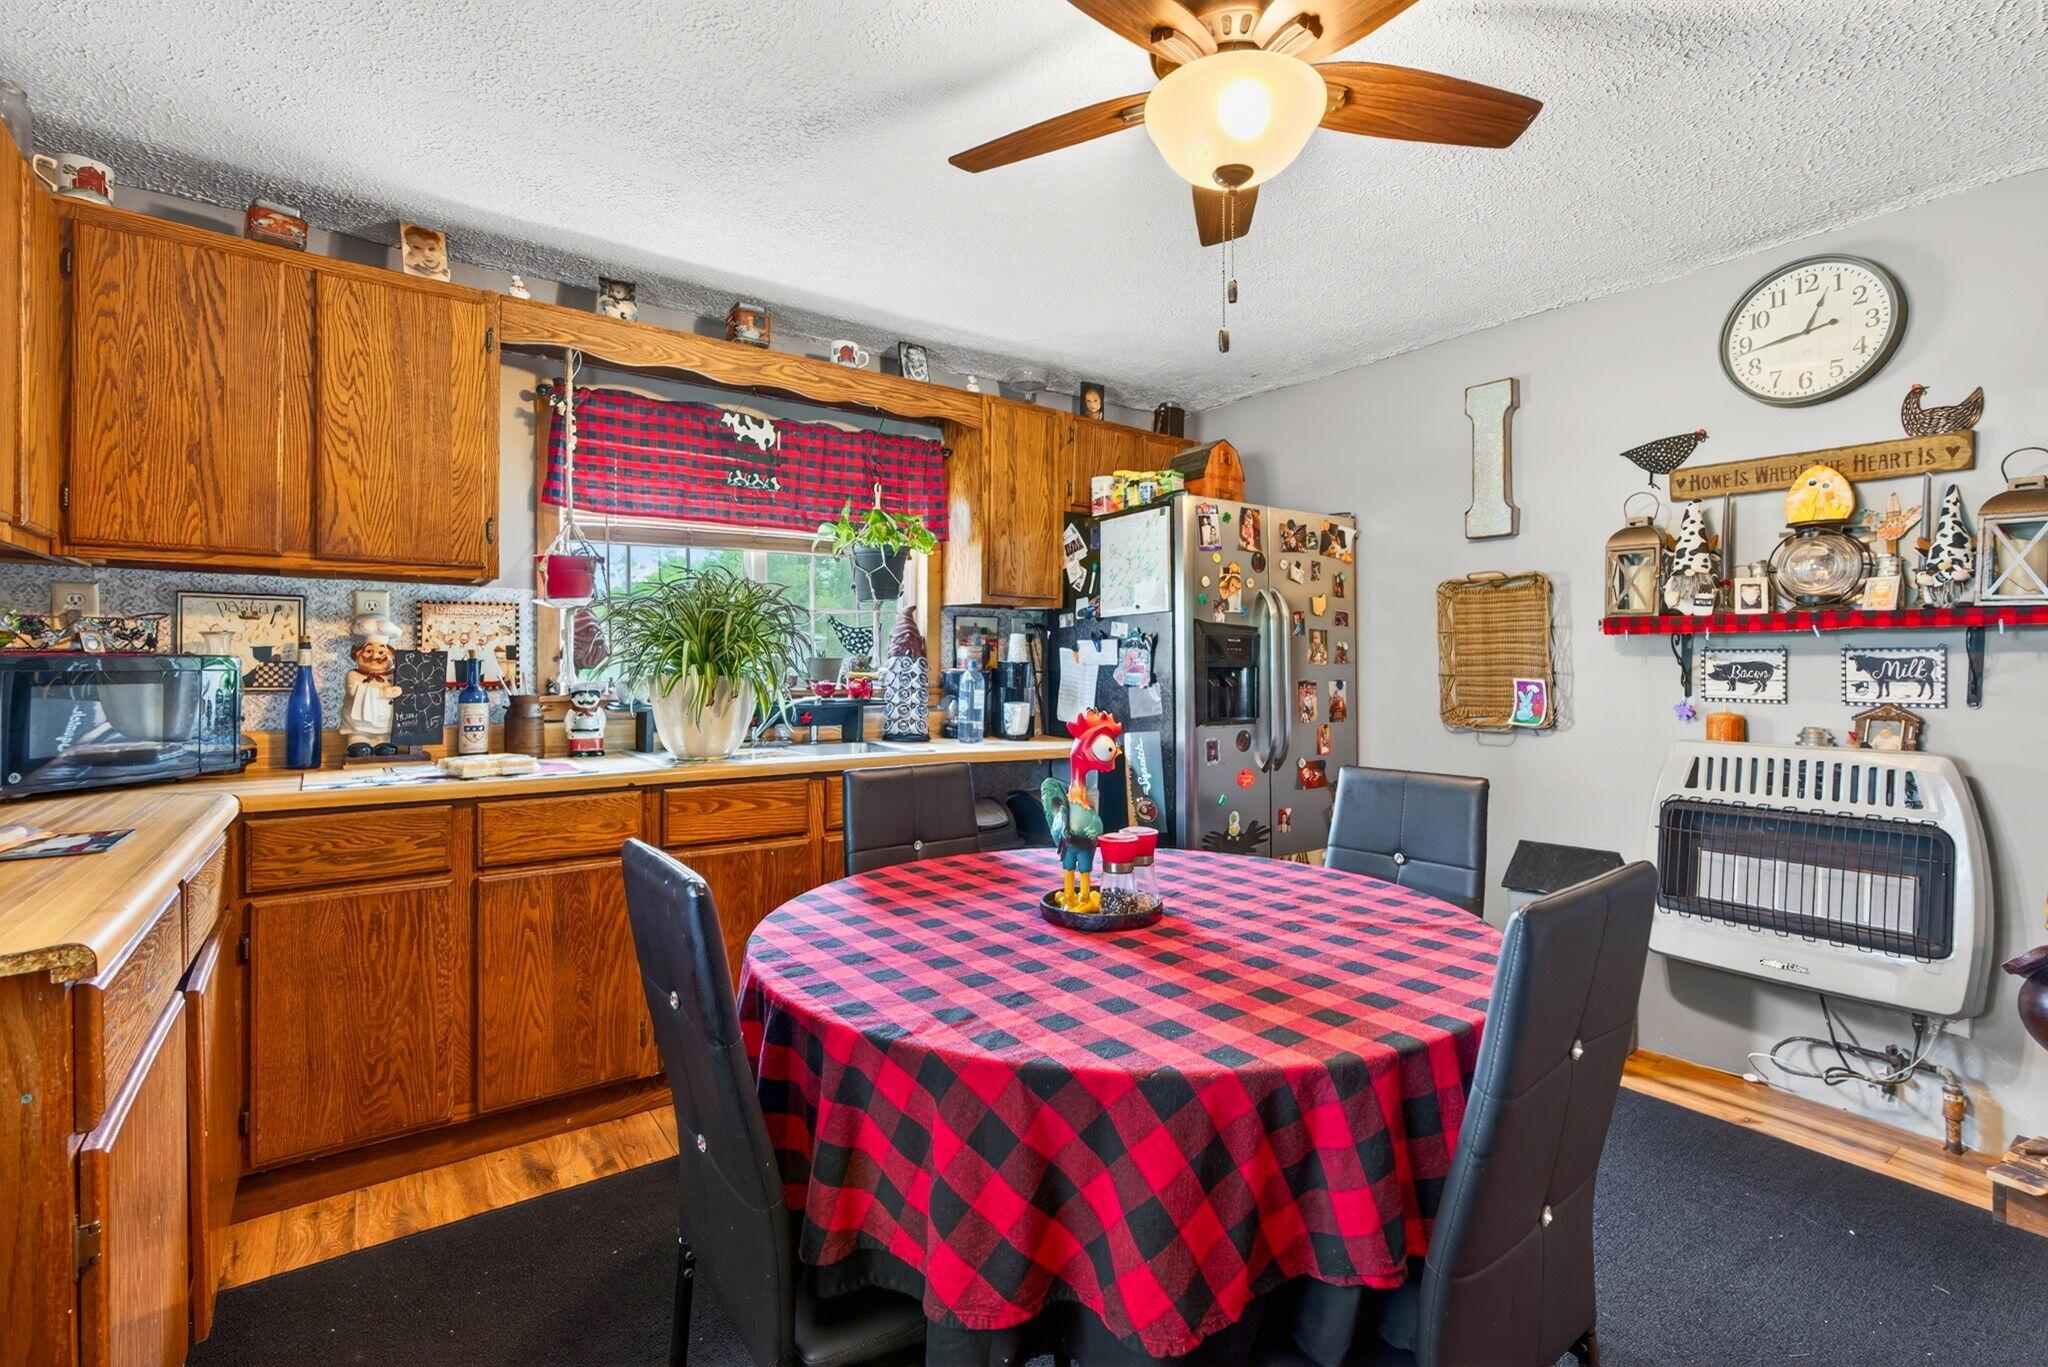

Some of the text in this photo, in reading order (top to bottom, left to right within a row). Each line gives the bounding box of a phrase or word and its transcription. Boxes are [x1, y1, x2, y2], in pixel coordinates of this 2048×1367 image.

[1795, 274, 1820, 296] 12
[1833, 273, 1843, 292] 1
[1769, 288, 1788, 309] 11
[1852, 285, 1869, 305] 2
[1749, 310, 1770, 330] 10
[1865, 308, 1880, 327] 3
[1739, 336, 1752, 356] 9
[1853, 335, 1867, 354] 4
[1749, 357, 1762, 376] 8
[1829, 358, 1844, 378] 5
[1769, 370, 1783, 389] 7
[1799, 370, 1813, 389] 6
[1728, 664, 1769, 679] Bacon
[1872, 658, 1928, 680] Milk
